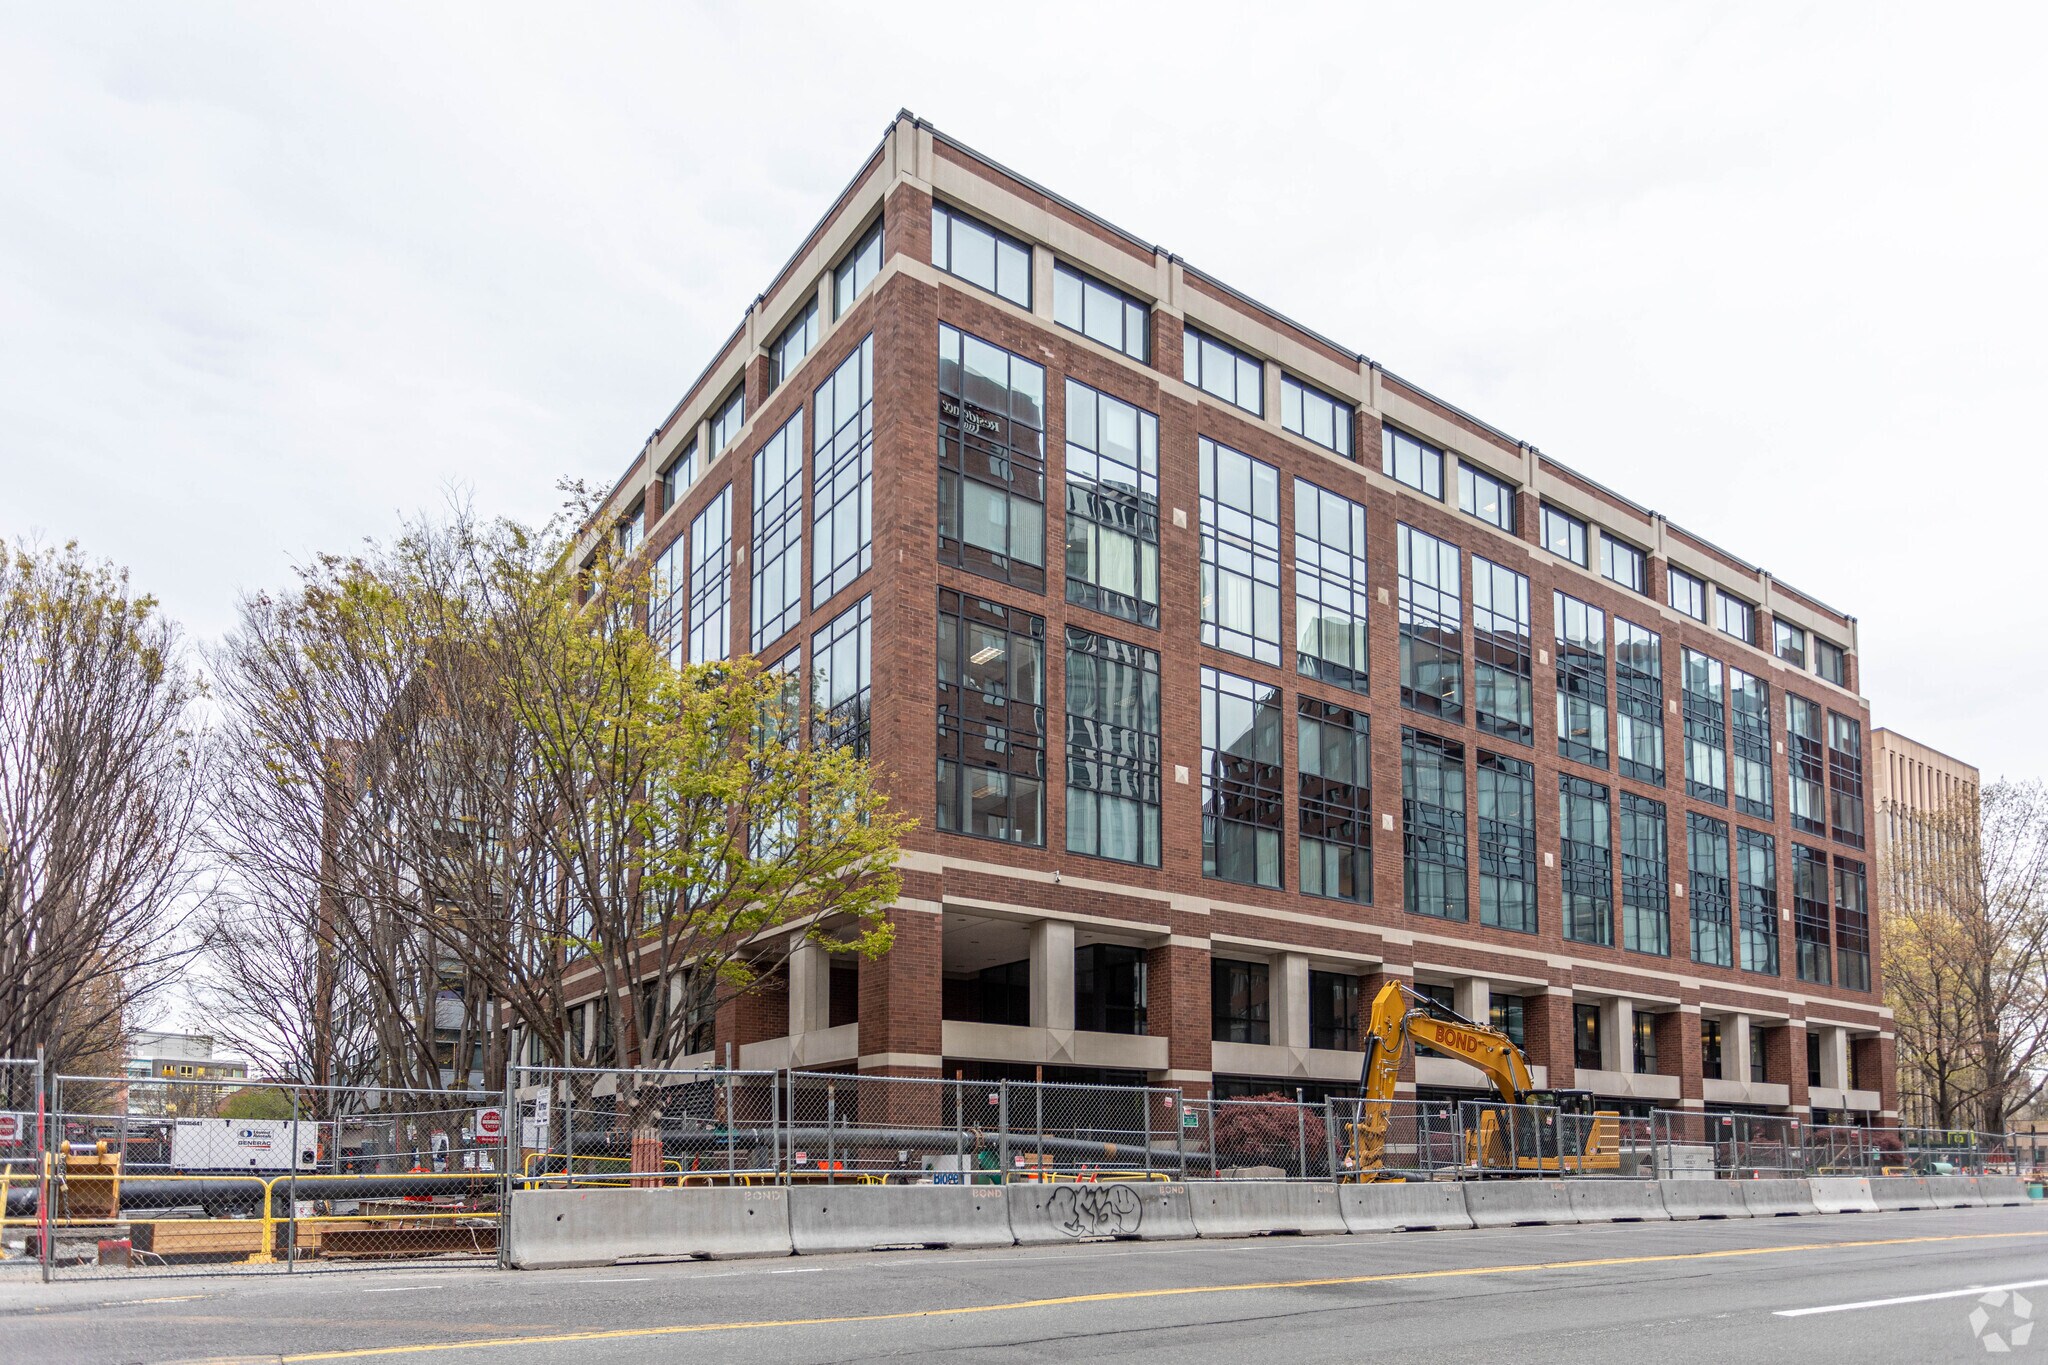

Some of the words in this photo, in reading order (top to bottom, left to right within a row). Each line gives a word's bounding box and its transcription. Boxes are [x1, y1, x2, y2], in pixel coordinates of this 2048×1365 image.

[1435, 1025, 1478, 1053] BOND
[972, 1188, 1002, 1198] BOND
[1159, 1185, 1185, 1195] BOND
[1312, 1185, 1335, 1194] BOND
[744, 1190, 781, 1201] BOND
